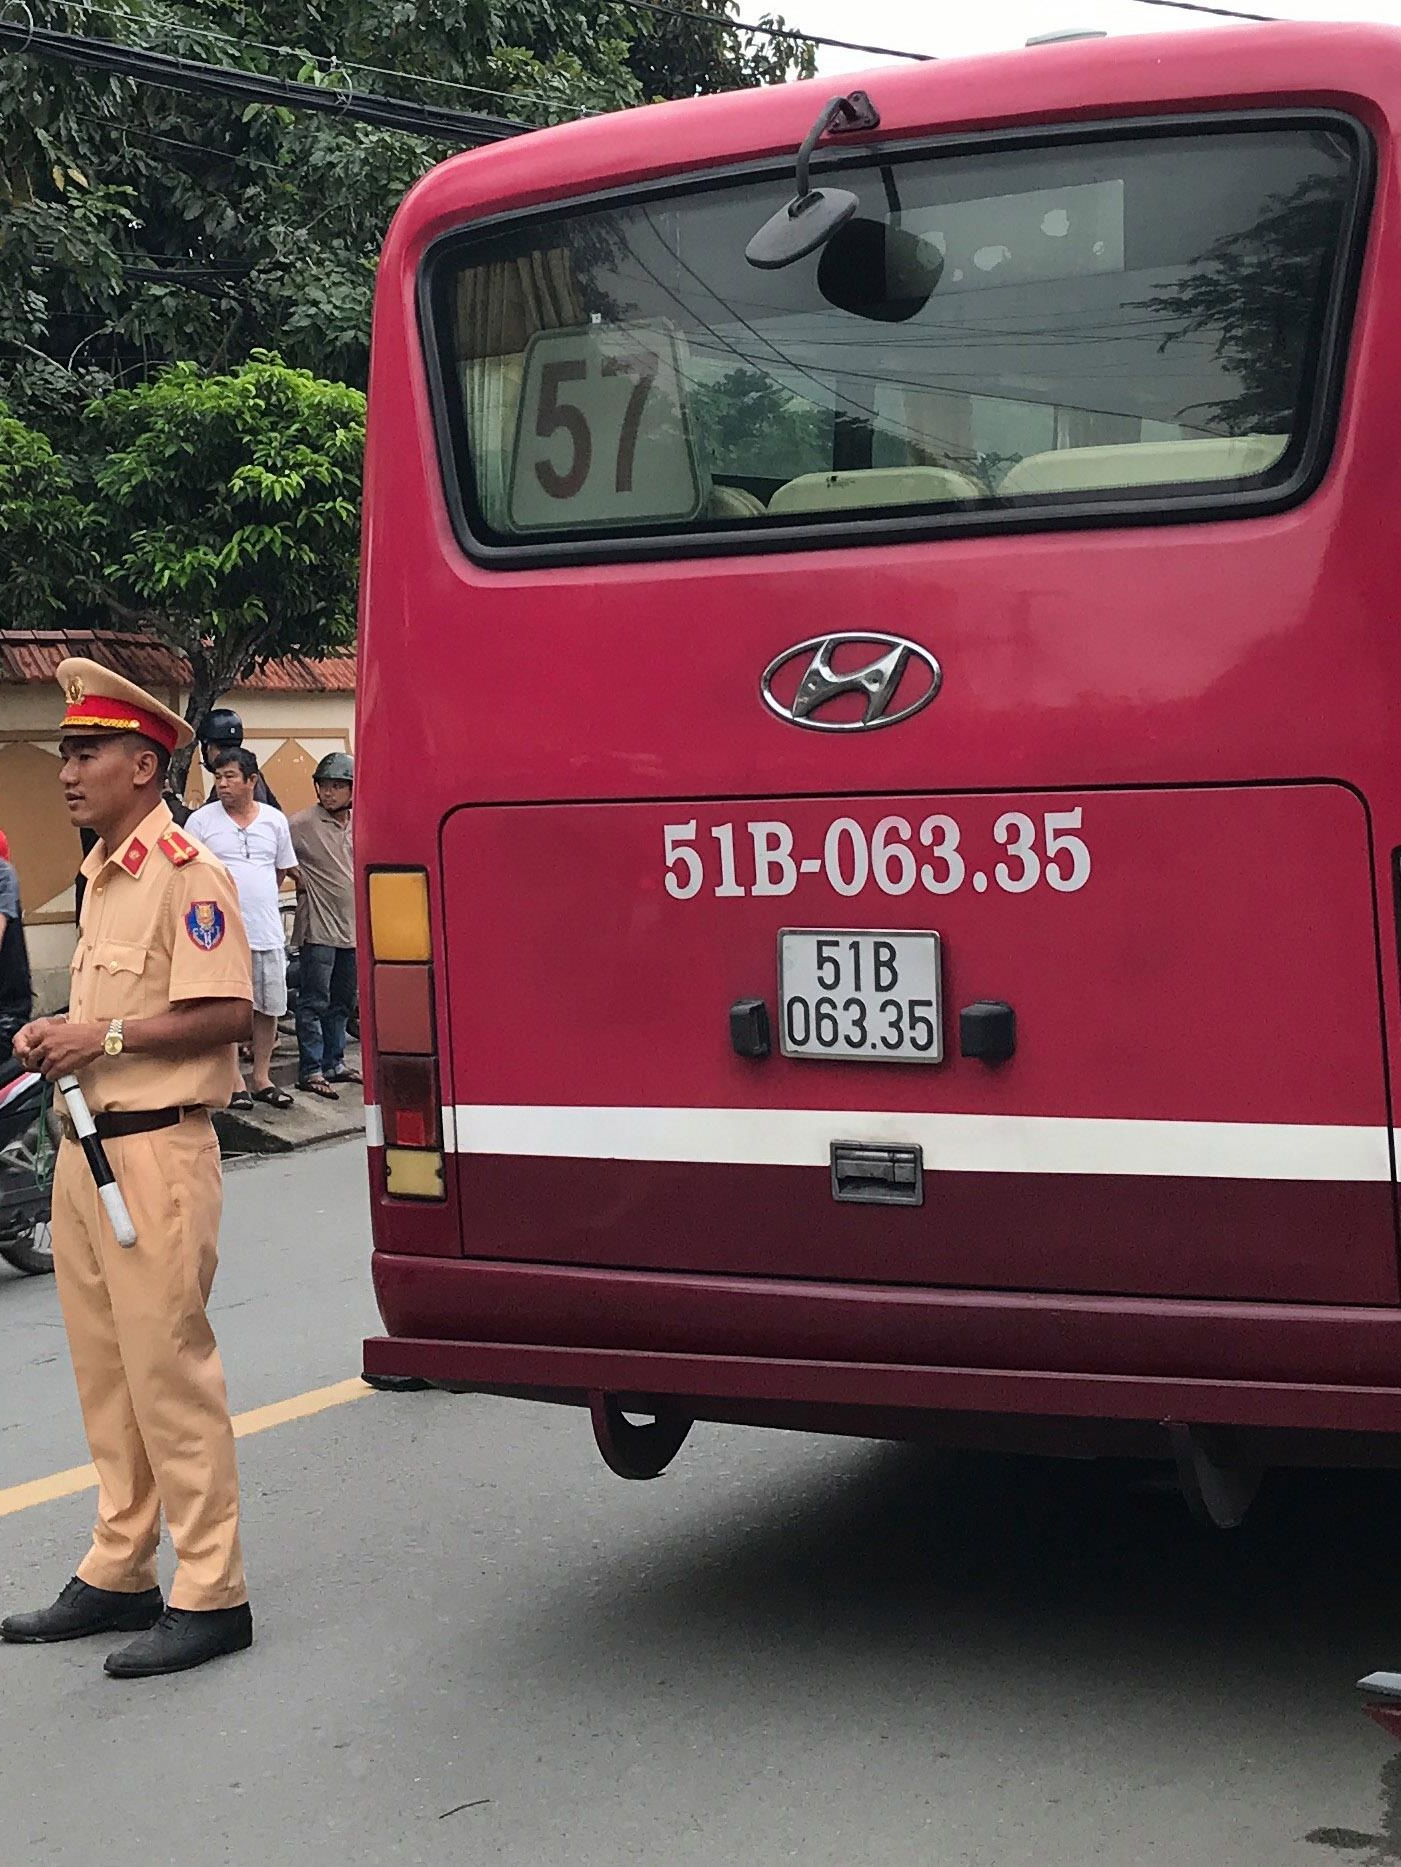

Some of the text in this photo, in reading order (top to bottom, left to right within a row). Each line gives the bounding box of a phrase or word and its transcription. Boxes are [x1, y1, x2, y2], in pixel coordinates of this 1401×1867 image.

[535, 350, 659, 499] 57
[663, 806, 1091, 899] 51B-063.35
[816, 939, 898, 993] 51B
[786, 995, 934, 1052] 063.35
